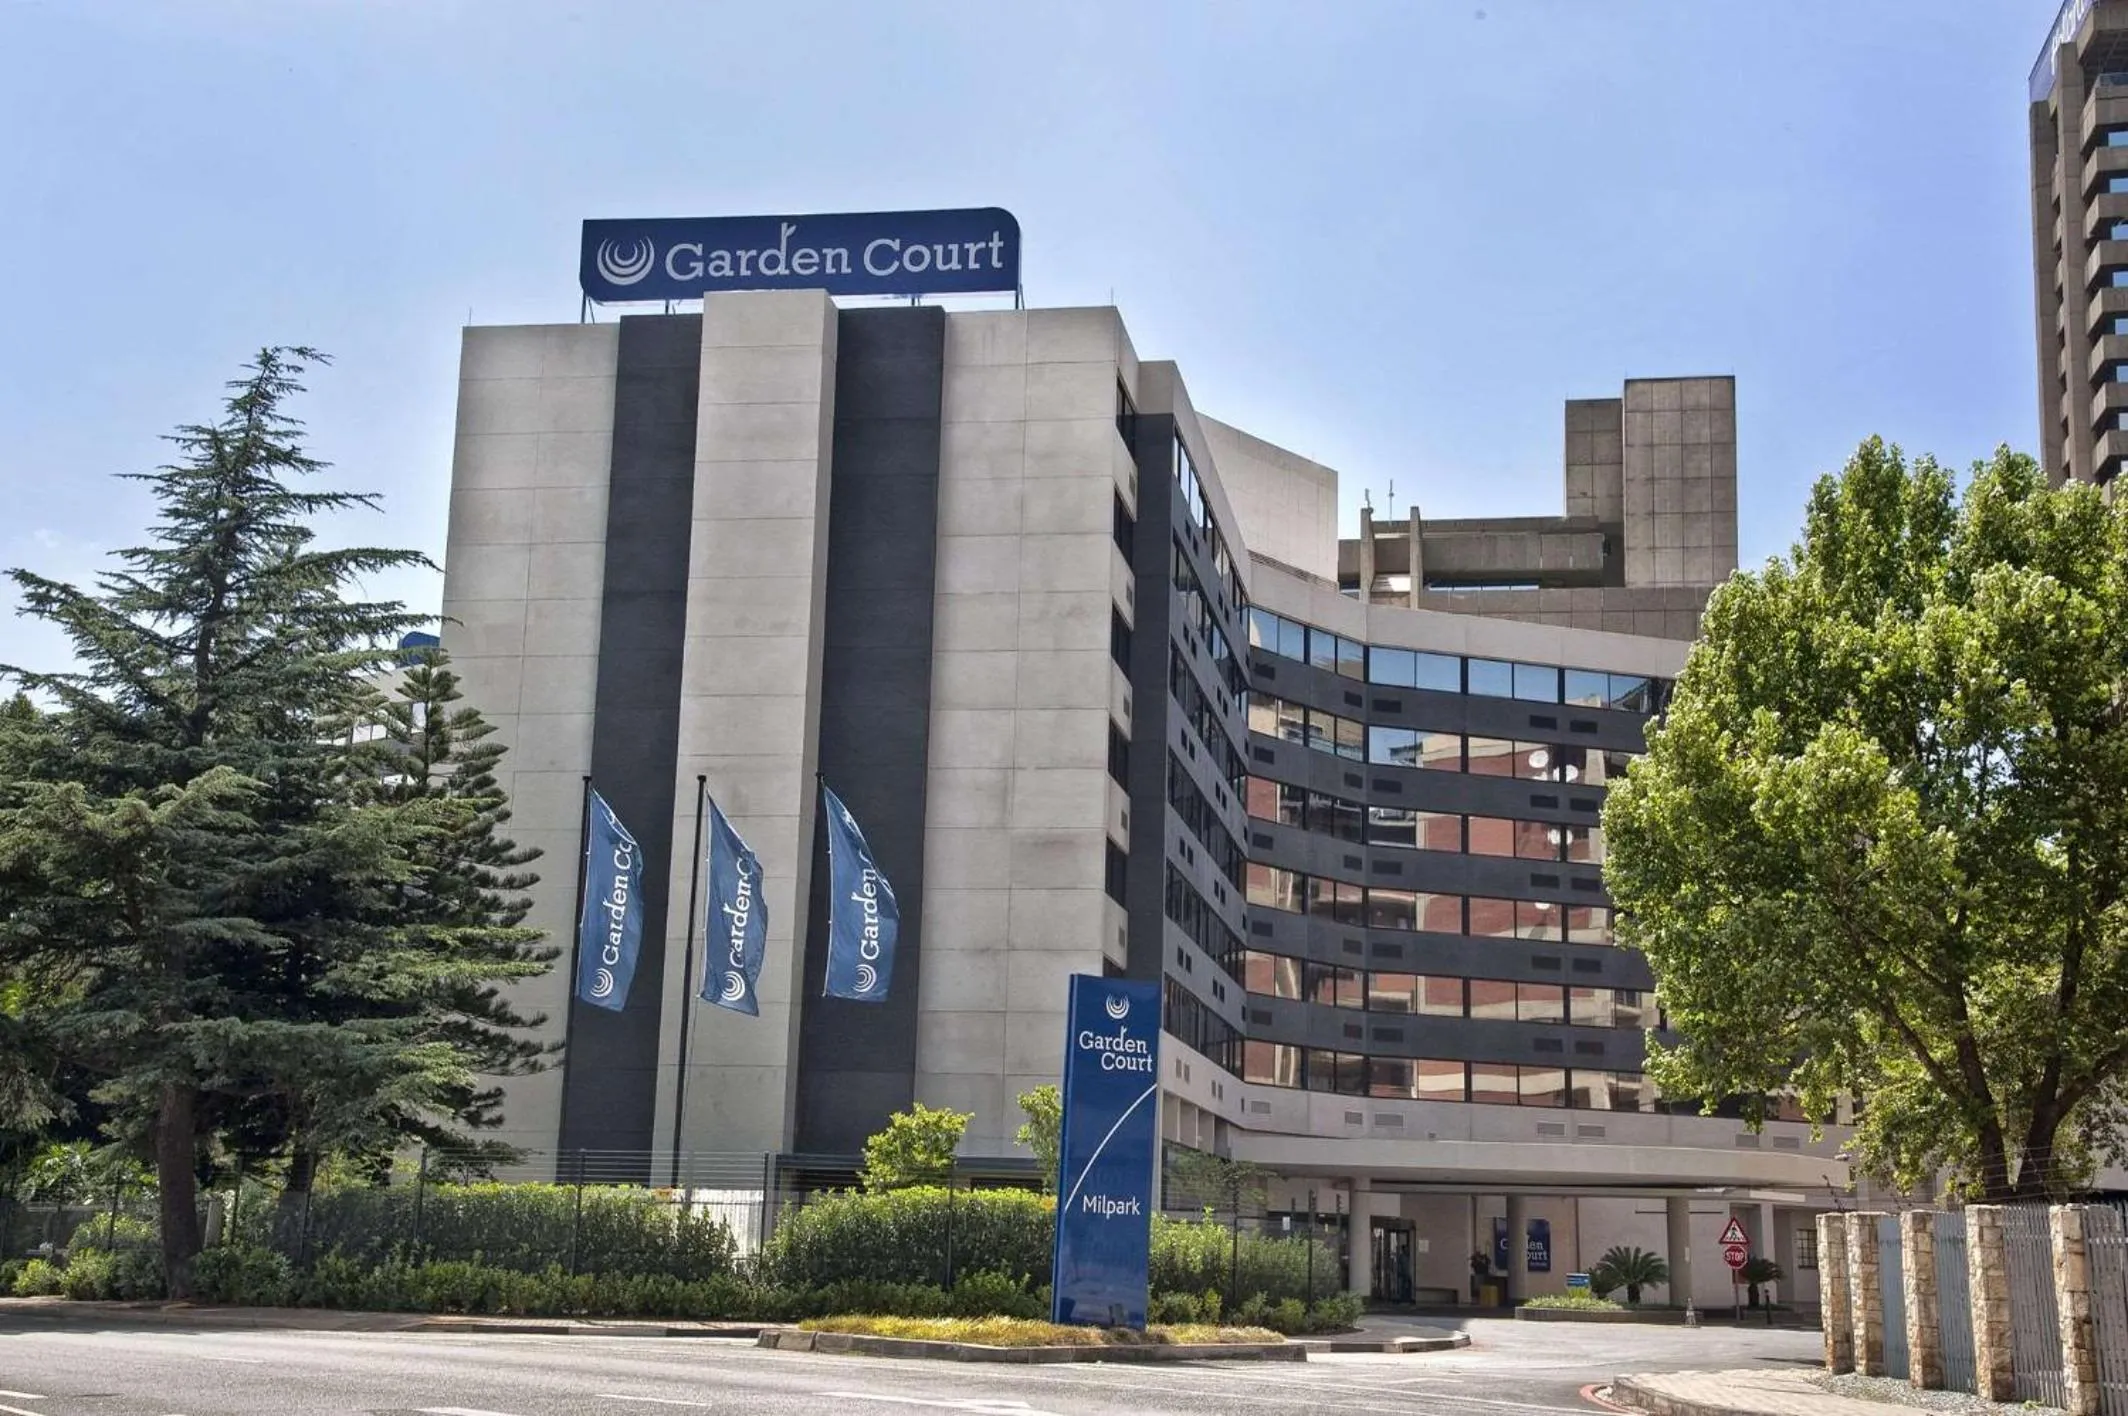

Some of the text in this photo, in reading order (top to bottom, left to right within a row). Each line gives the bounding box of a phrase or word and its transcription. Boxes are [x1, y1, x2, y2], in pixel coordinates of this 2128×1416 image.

[665, 222, 1004, 282] Garden Court
[602, 875, 629, 966] Garden
[851, 868, 880, 960] Garden
[1079, 1025, 1148, 1054] Garden
[1101, 1052, 1153, 1072] Court
[1083, 1194, 1141, 1220] Milpark
[1725, 1250, 1745, 1262] STOP
